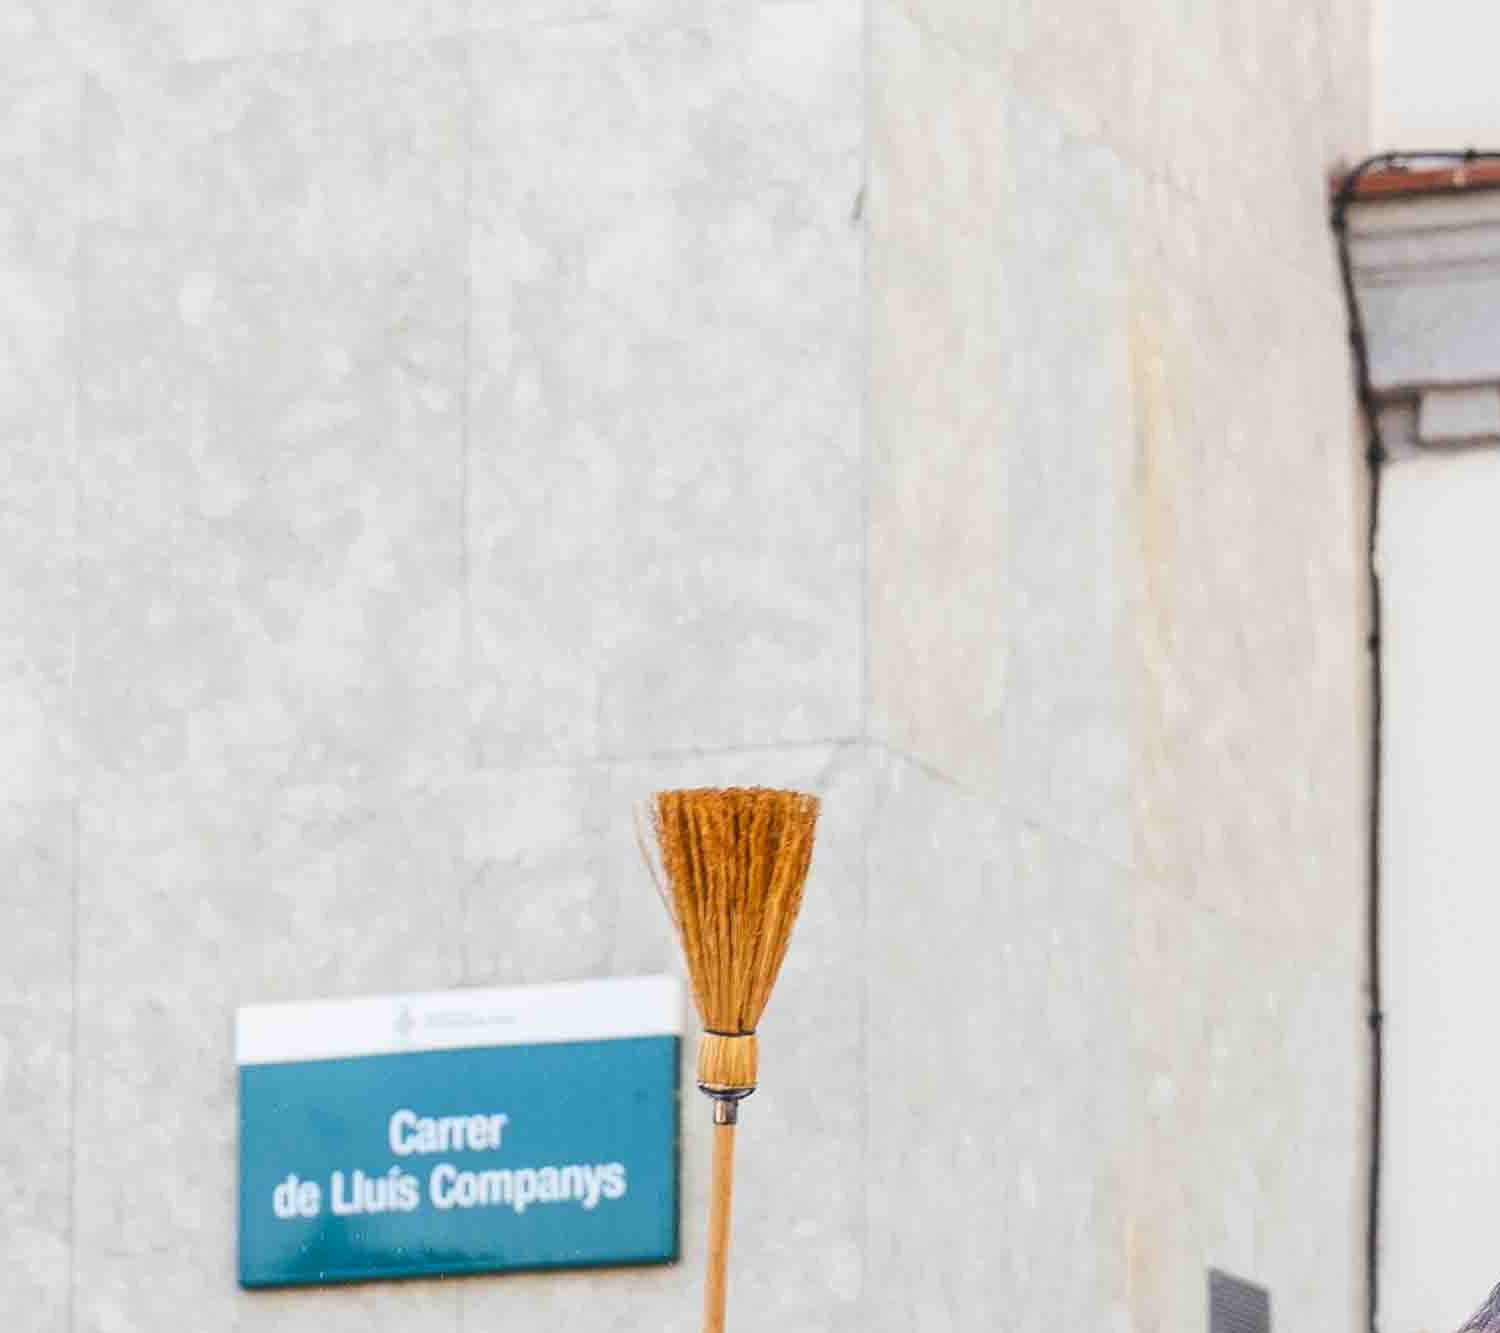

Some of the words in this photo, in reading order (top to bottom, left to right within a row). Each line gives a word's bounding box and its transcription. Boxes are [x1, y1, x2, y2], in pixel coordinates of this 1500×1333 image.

[390, 1111, 505, 1154] Carrer
[274, 1175, 320, 1217] de
[332, 1167, 419, 1214] Lluís
[431, 1163, 625, 1211] Companys
